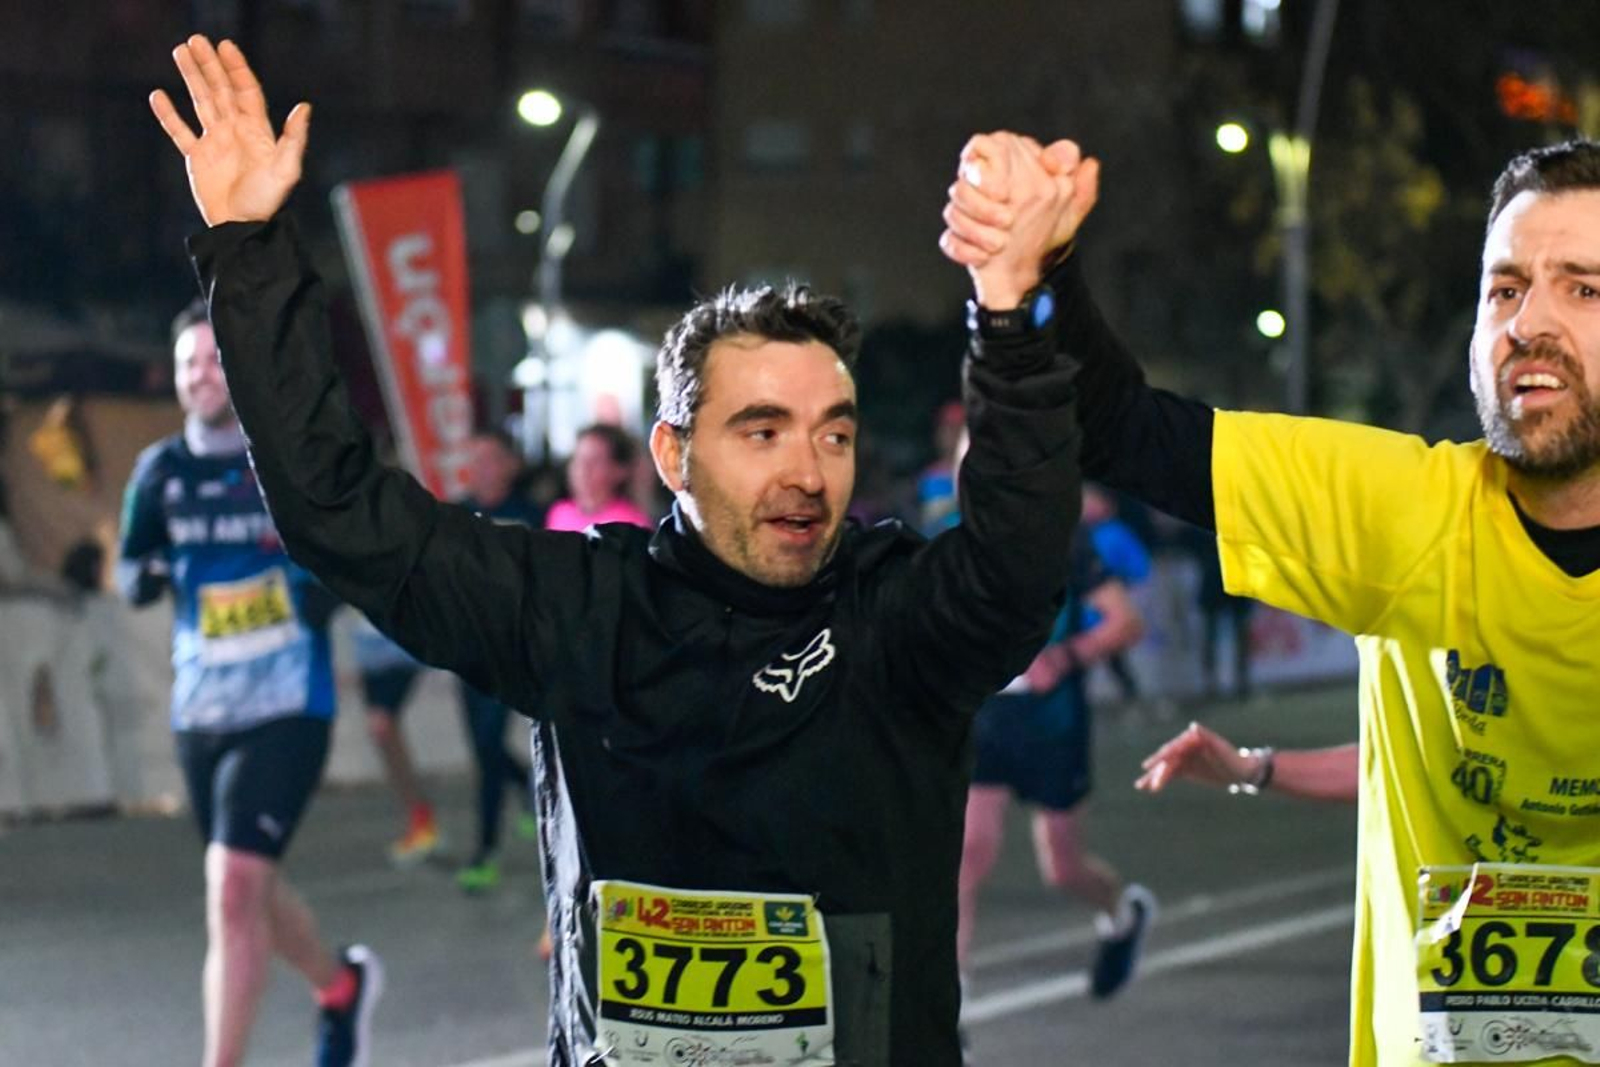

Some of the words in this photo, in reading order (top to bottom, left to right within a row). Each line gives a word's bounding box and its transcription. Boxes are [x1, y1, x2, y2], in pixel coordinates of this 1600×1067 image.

[1451, 760, 1494, 804] 40
[1549, 777, 1600, 796] MEM
[637, 896, 672, 930] 42
[613, 937, 807, 1008] 3773
